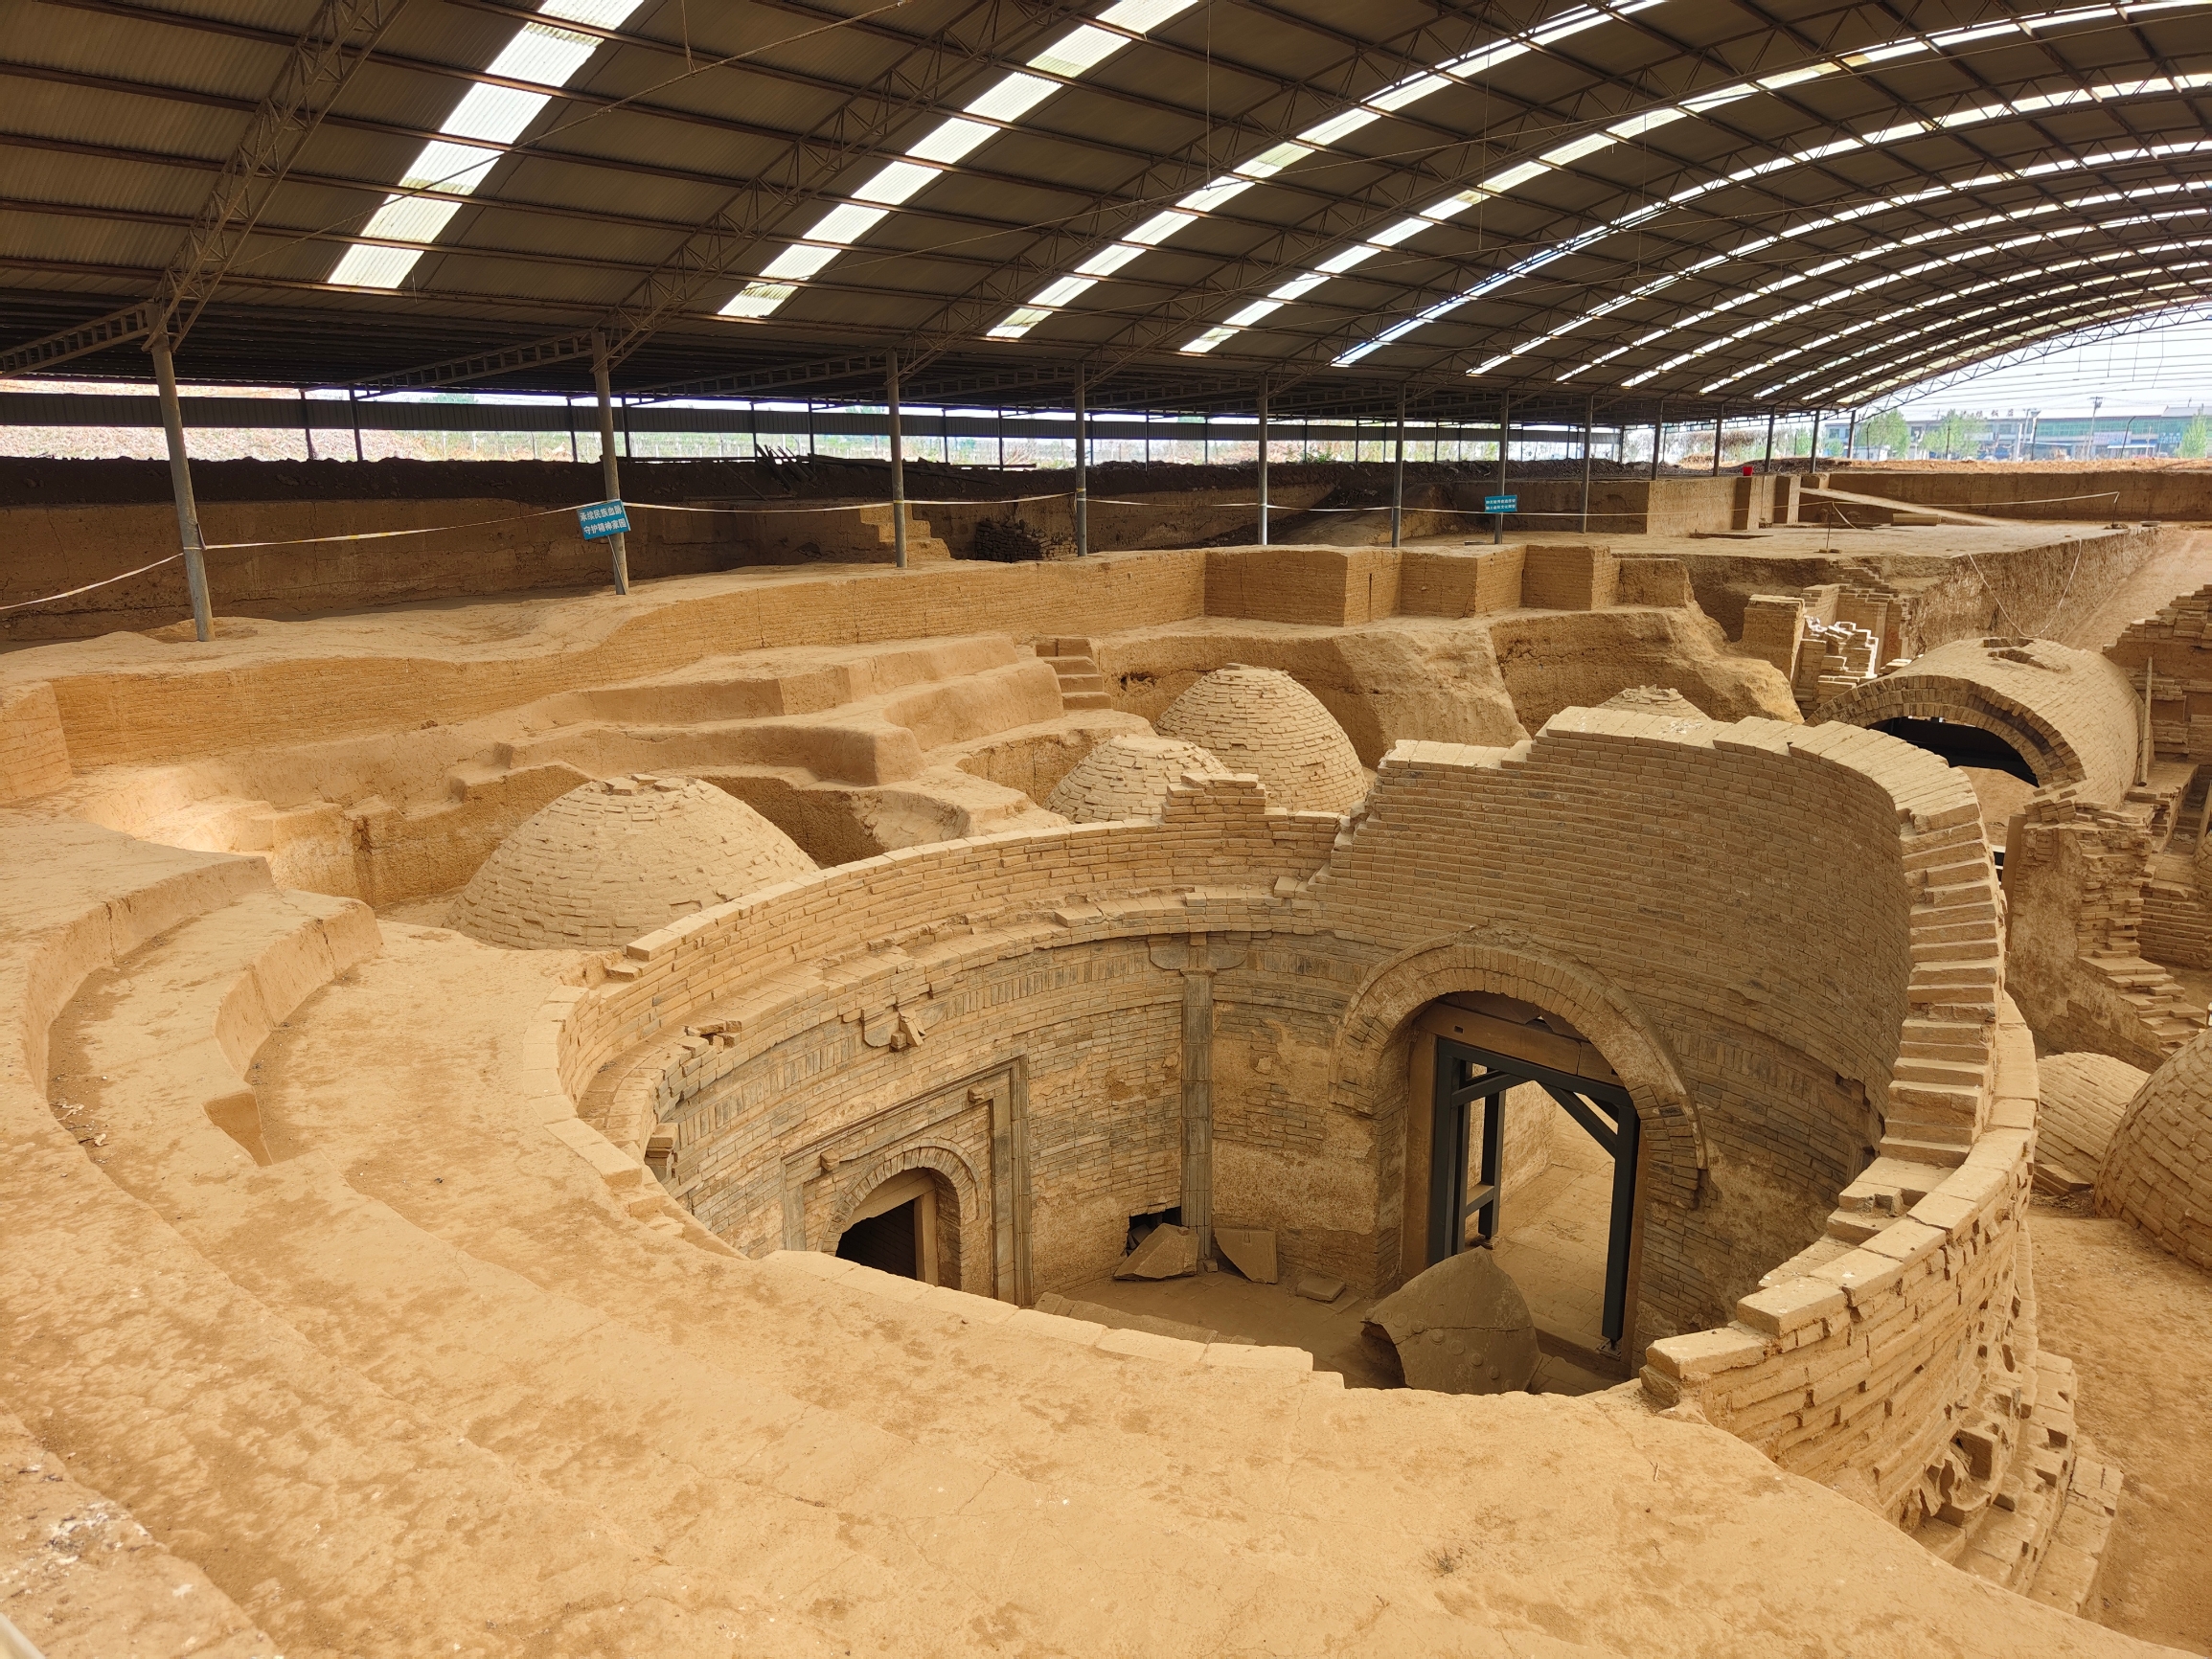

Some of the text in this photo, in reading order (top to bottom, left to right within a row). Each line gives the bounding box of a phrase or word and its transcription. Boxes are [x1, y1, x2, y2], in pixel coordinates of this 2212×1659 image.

[580, 505, 623, 522] 承续民族血脉
[583, 518, 627, 534] 守护精神家园
